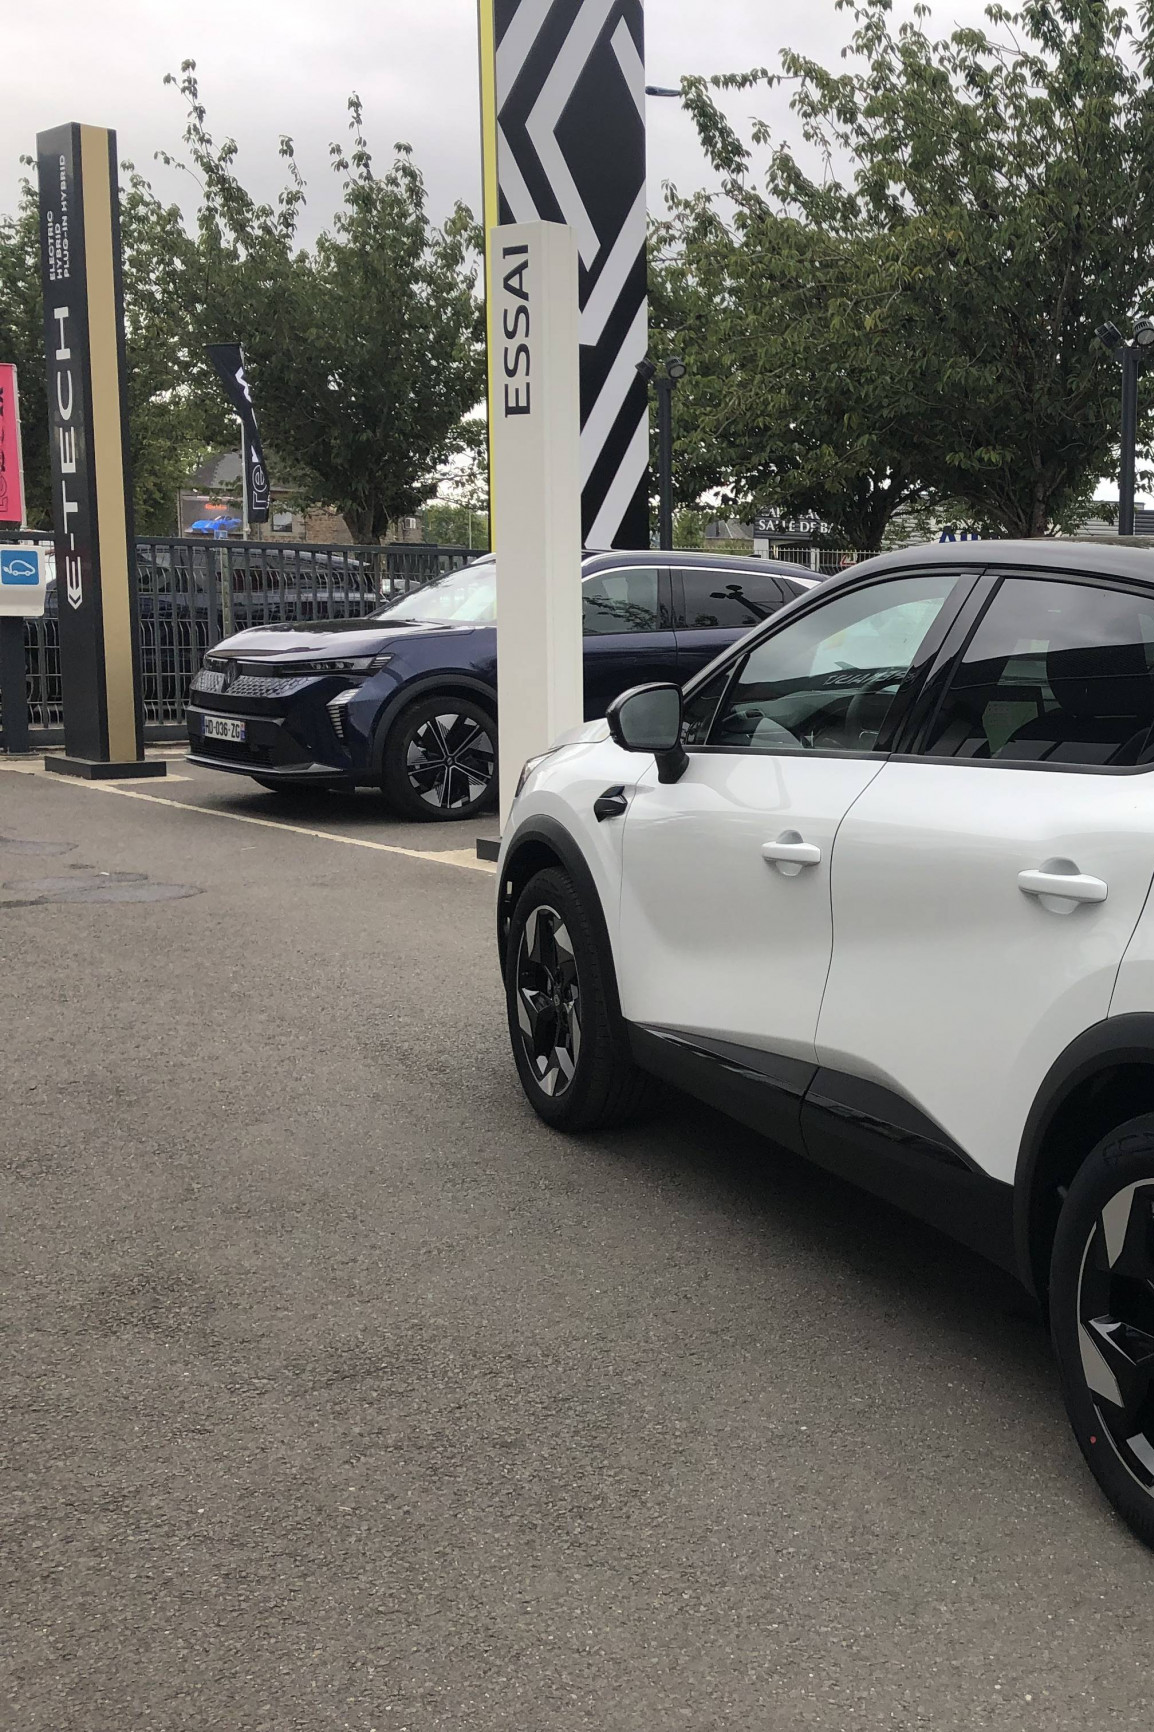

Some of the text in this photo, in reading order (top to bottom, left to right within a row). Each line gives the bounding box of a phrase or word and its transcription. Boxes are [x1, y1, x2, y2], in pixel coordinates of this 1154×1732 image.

[47, 210, 56, 281] ELECTRIC
[55, 223, 63, 279] HYBRID
[59, 154, 70, 278] PLUG-IN HYBRID
[502, 244, 531, 418] ESSAI
[54, 306, 83, 610] E-TECH
[205, 718, 240, 739] HD-036-ZG
